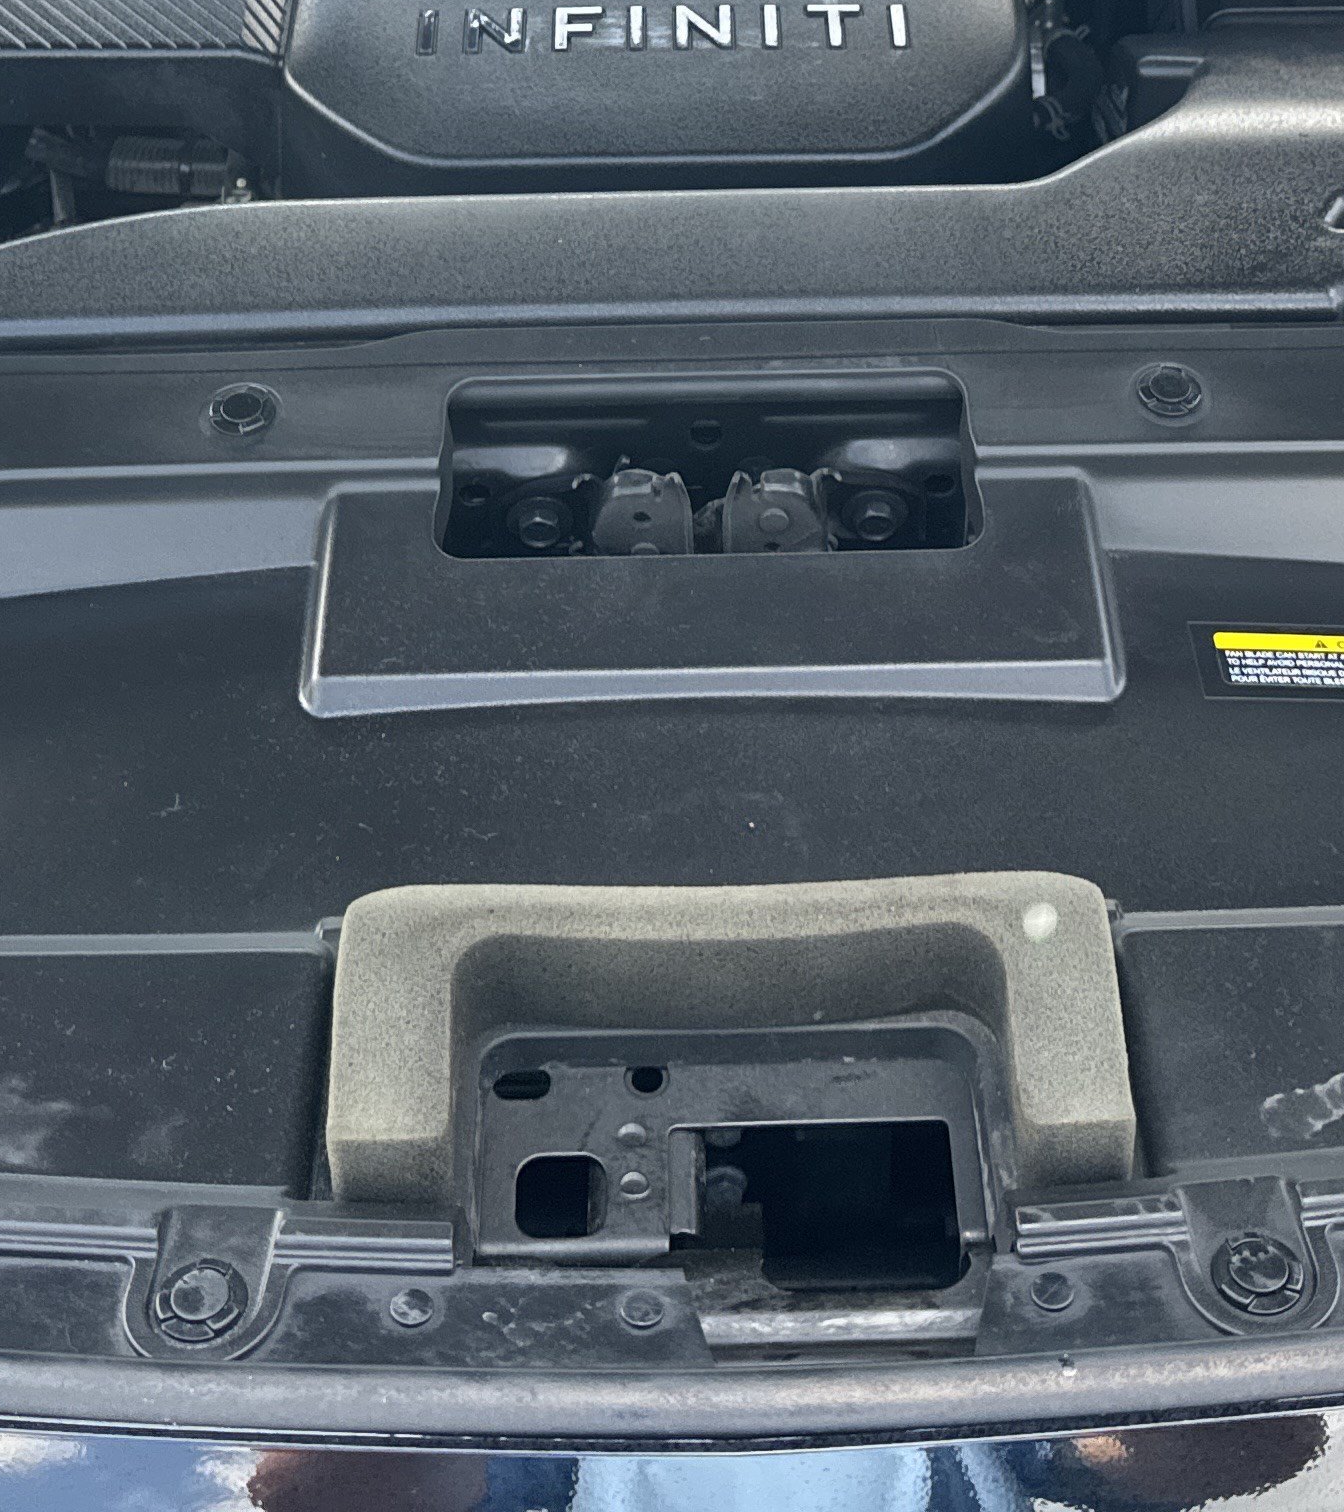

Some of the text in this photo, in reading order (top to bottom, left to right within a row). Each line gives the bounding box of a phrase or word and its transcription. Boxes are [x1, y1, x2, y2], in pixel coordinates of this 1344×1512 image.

[417, 4, 911, 55] INFINITI
[1224, 650, 1244, 658] FAN
[1244, 650, 1275, 659] BLADE
[1276, 651, 1296, 659] CAN
[1297, 652, 1326, 660] START
[1227, 657, 1241, 665] TO
[1241, 658, 1266, 666] HELP
[1267, 658, 1296, 667] AVOID
[1229, 667, 1242, 675] LE
[1241, 667, 1302, 676] VENTILATEUR
[1302, 669, 1337, 677] RISQUE
[1231, 675, 1259, 683] POUR
[1291, 676, 1323, 685] TOUTE
